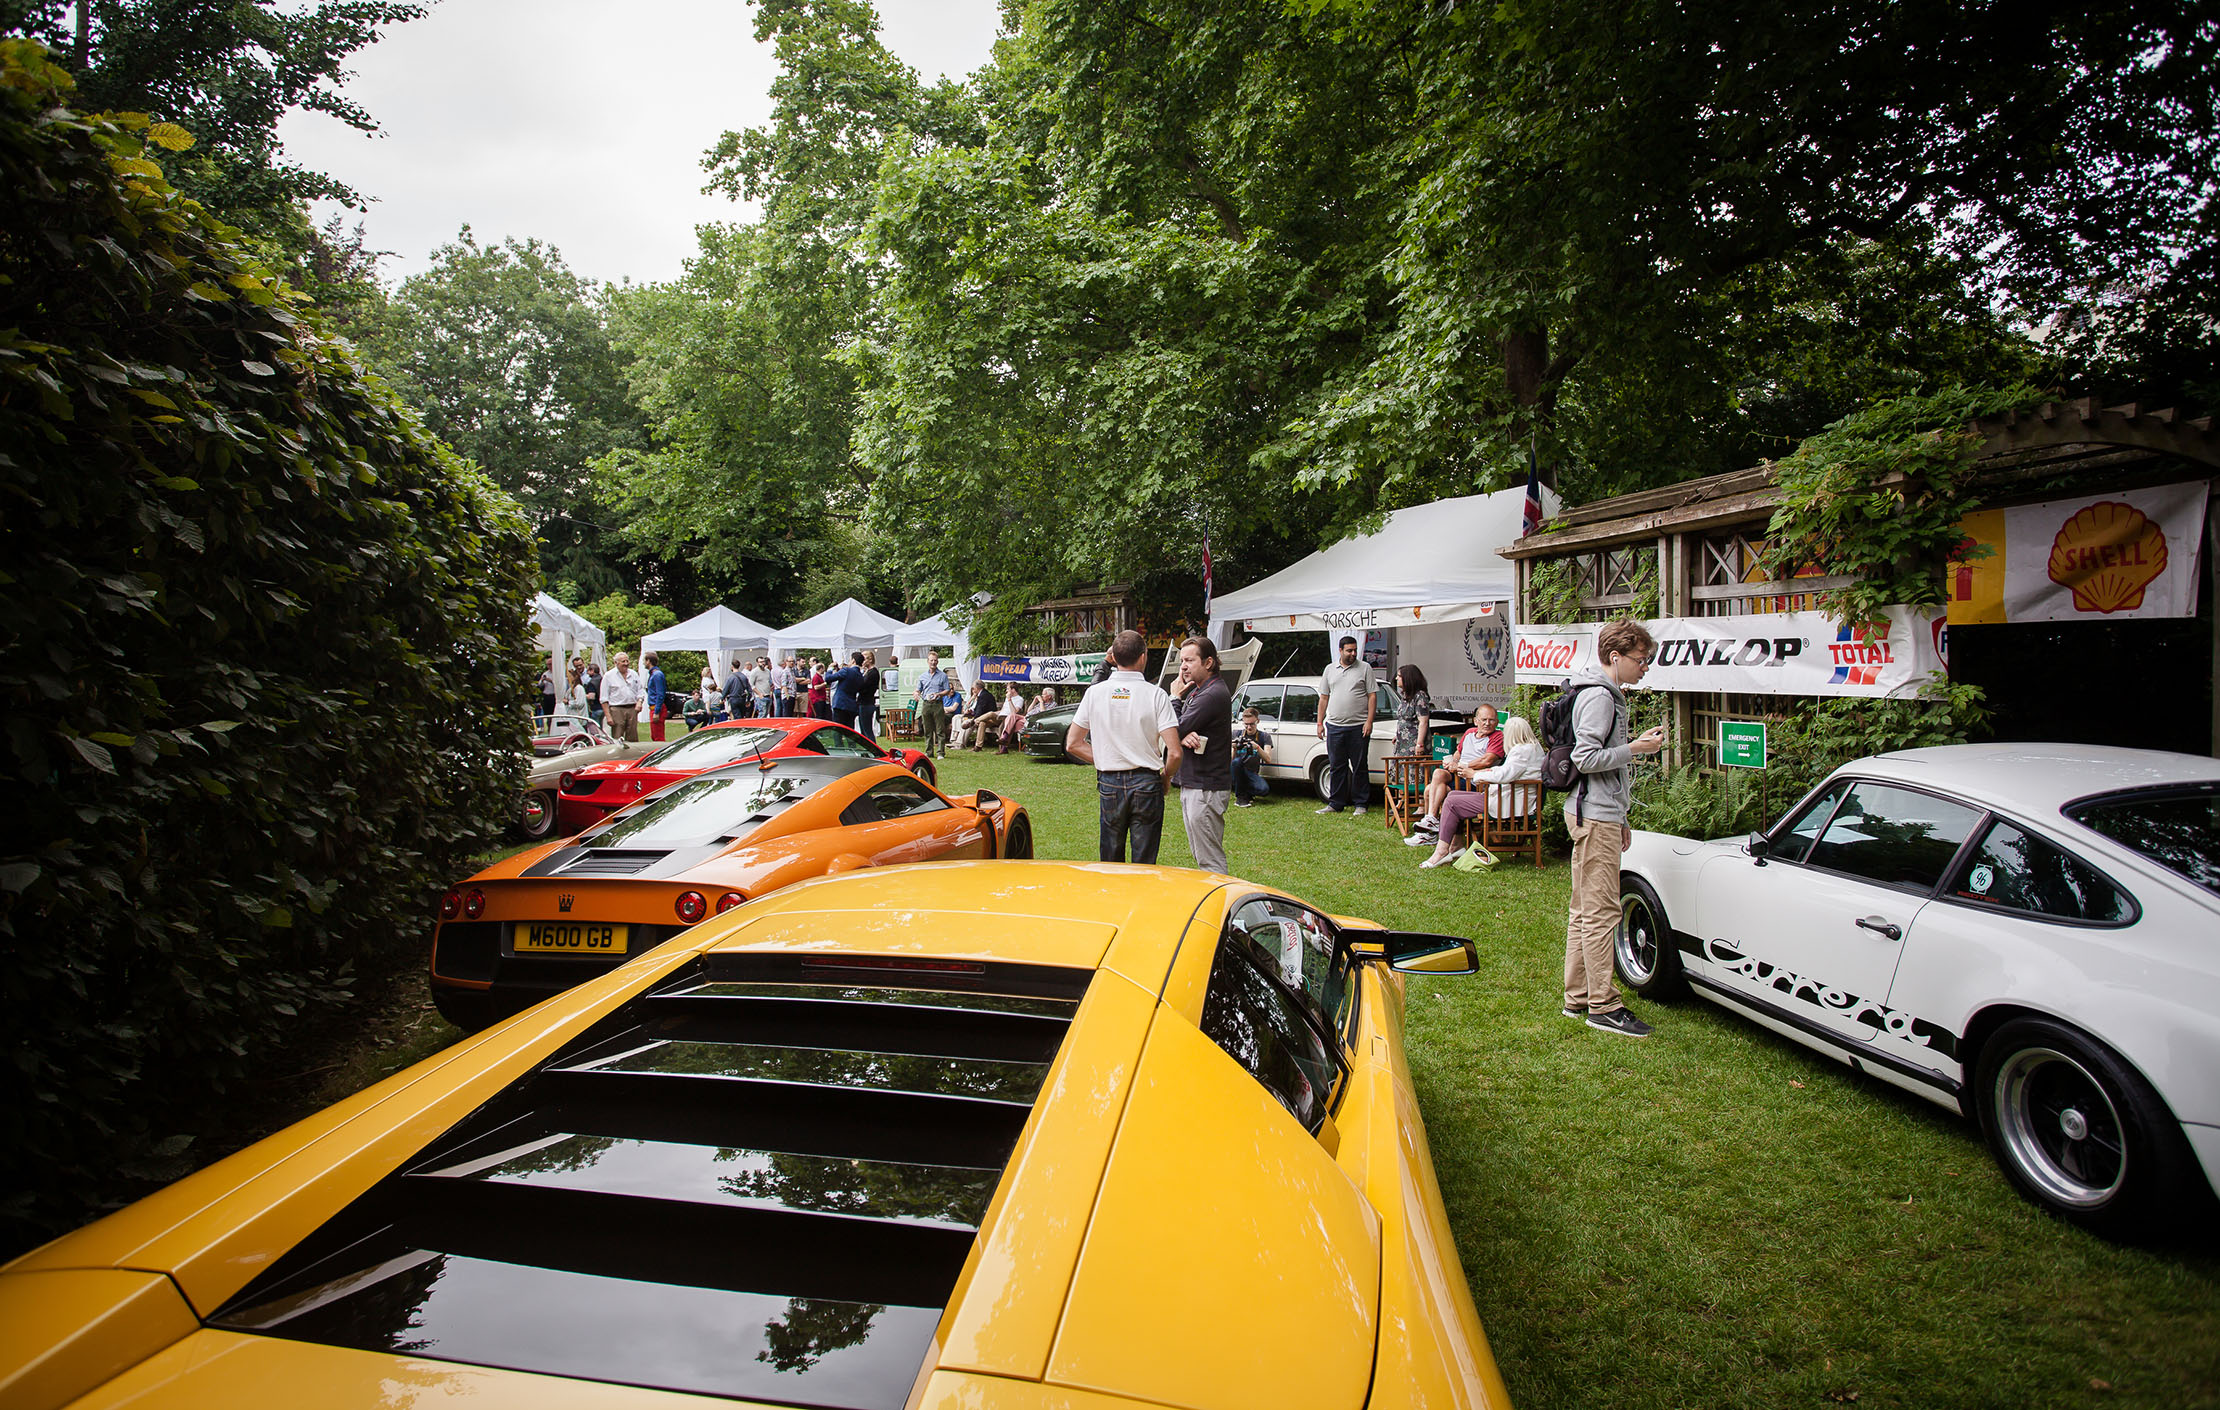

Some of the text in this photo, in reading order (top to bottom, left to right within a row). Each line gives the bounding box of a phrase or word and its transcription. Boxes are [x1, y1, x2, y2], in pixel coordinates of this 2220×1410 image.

[2065, 541, 2149, 571] SHELL
[1322, 609, 1378, 629] PORSCHE
[1516, 638, 1578, 669] Castrol
[1648, 638, 1802, 667] UNLOP
[1828, 642, 1895, 665] TOTAL
[1462, 683, 1485, 693] THE
[1728, 734, 1760, 742] EMERGENCY
[528, 925, 613, 948] M600 GB
[1703, 938, 1931, 1046] Carrera
